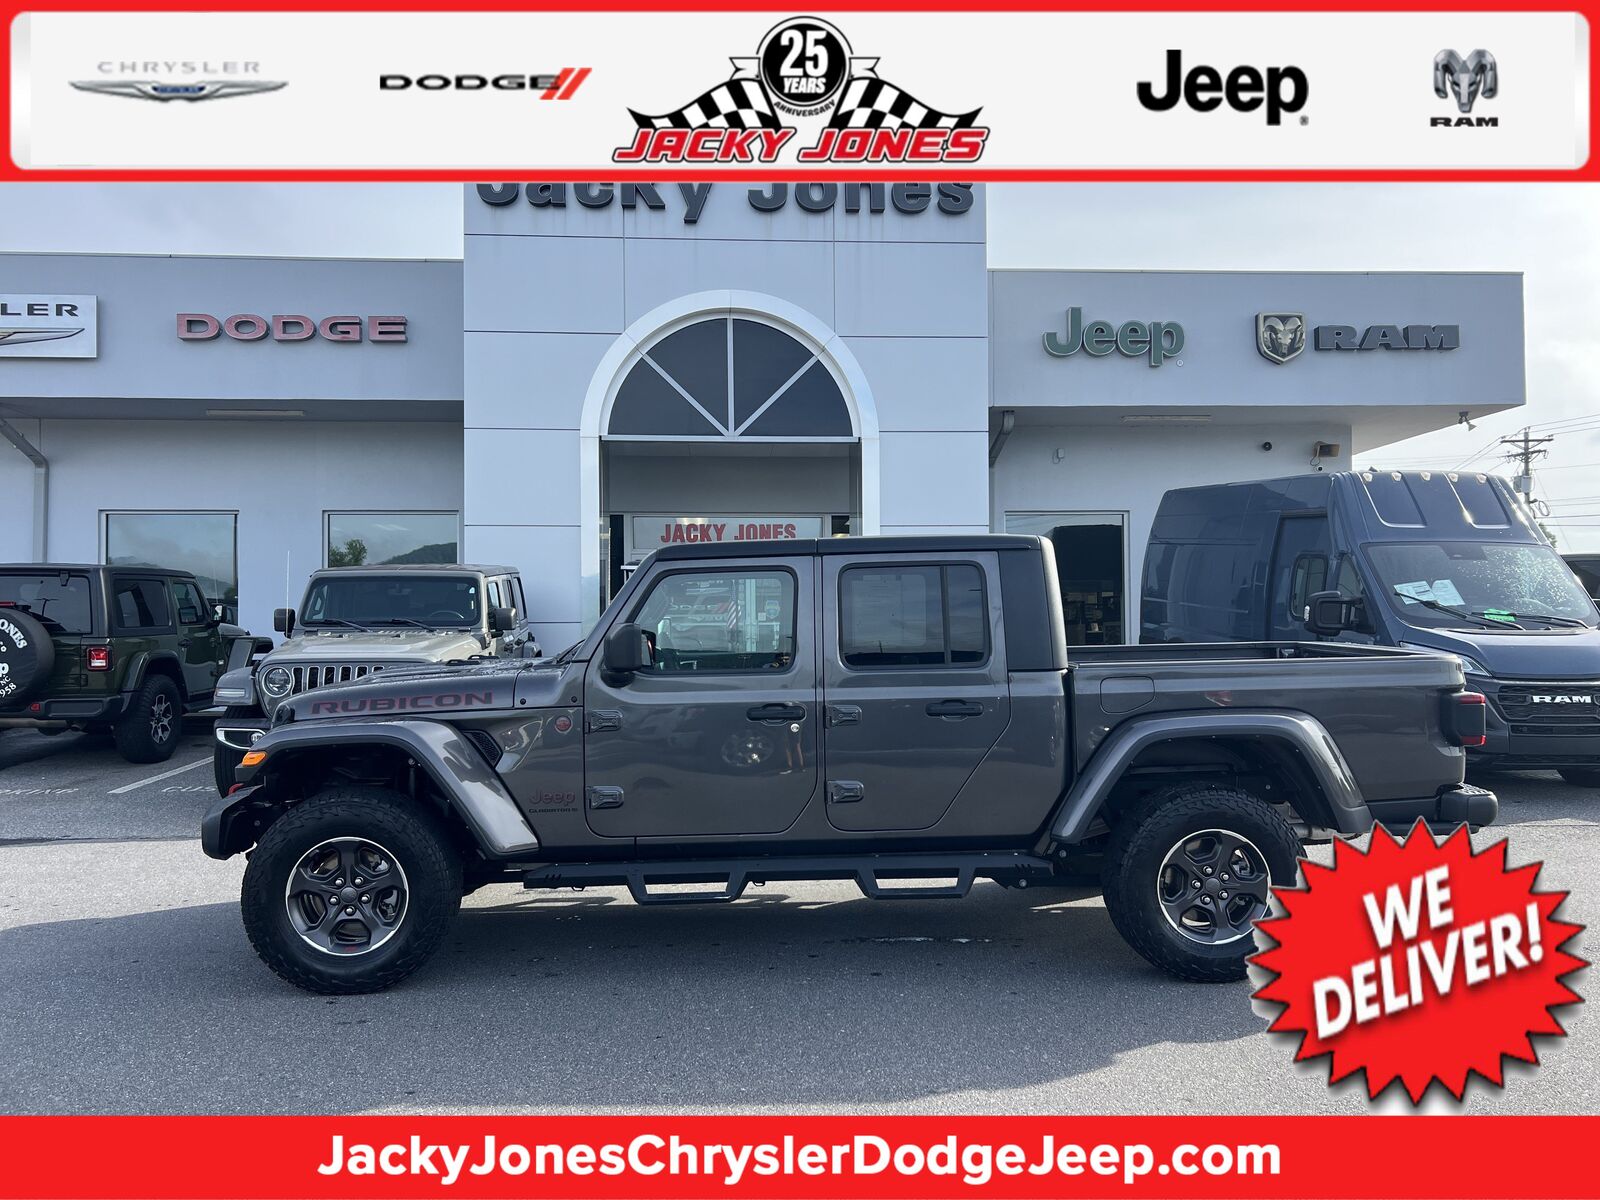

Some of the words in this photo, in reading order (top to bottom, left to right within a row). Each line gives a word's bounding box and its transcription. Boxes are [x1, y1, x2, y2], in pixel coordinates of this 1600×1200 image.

[0, 303, 79, 317] LER
[176, 313, 408, 343] DODGE
[1042, 306, 1185, 368] Jeep
[1314, 324, 1460, 352] RAM
[661, 523, 727, 543] JACKY
[733, 523, 797, 541] JONES
[311, 692, 494, 715] RUBICON
[1532, 695, 1592, 704] RAM
[529, 789, 576, 806] Jeep
